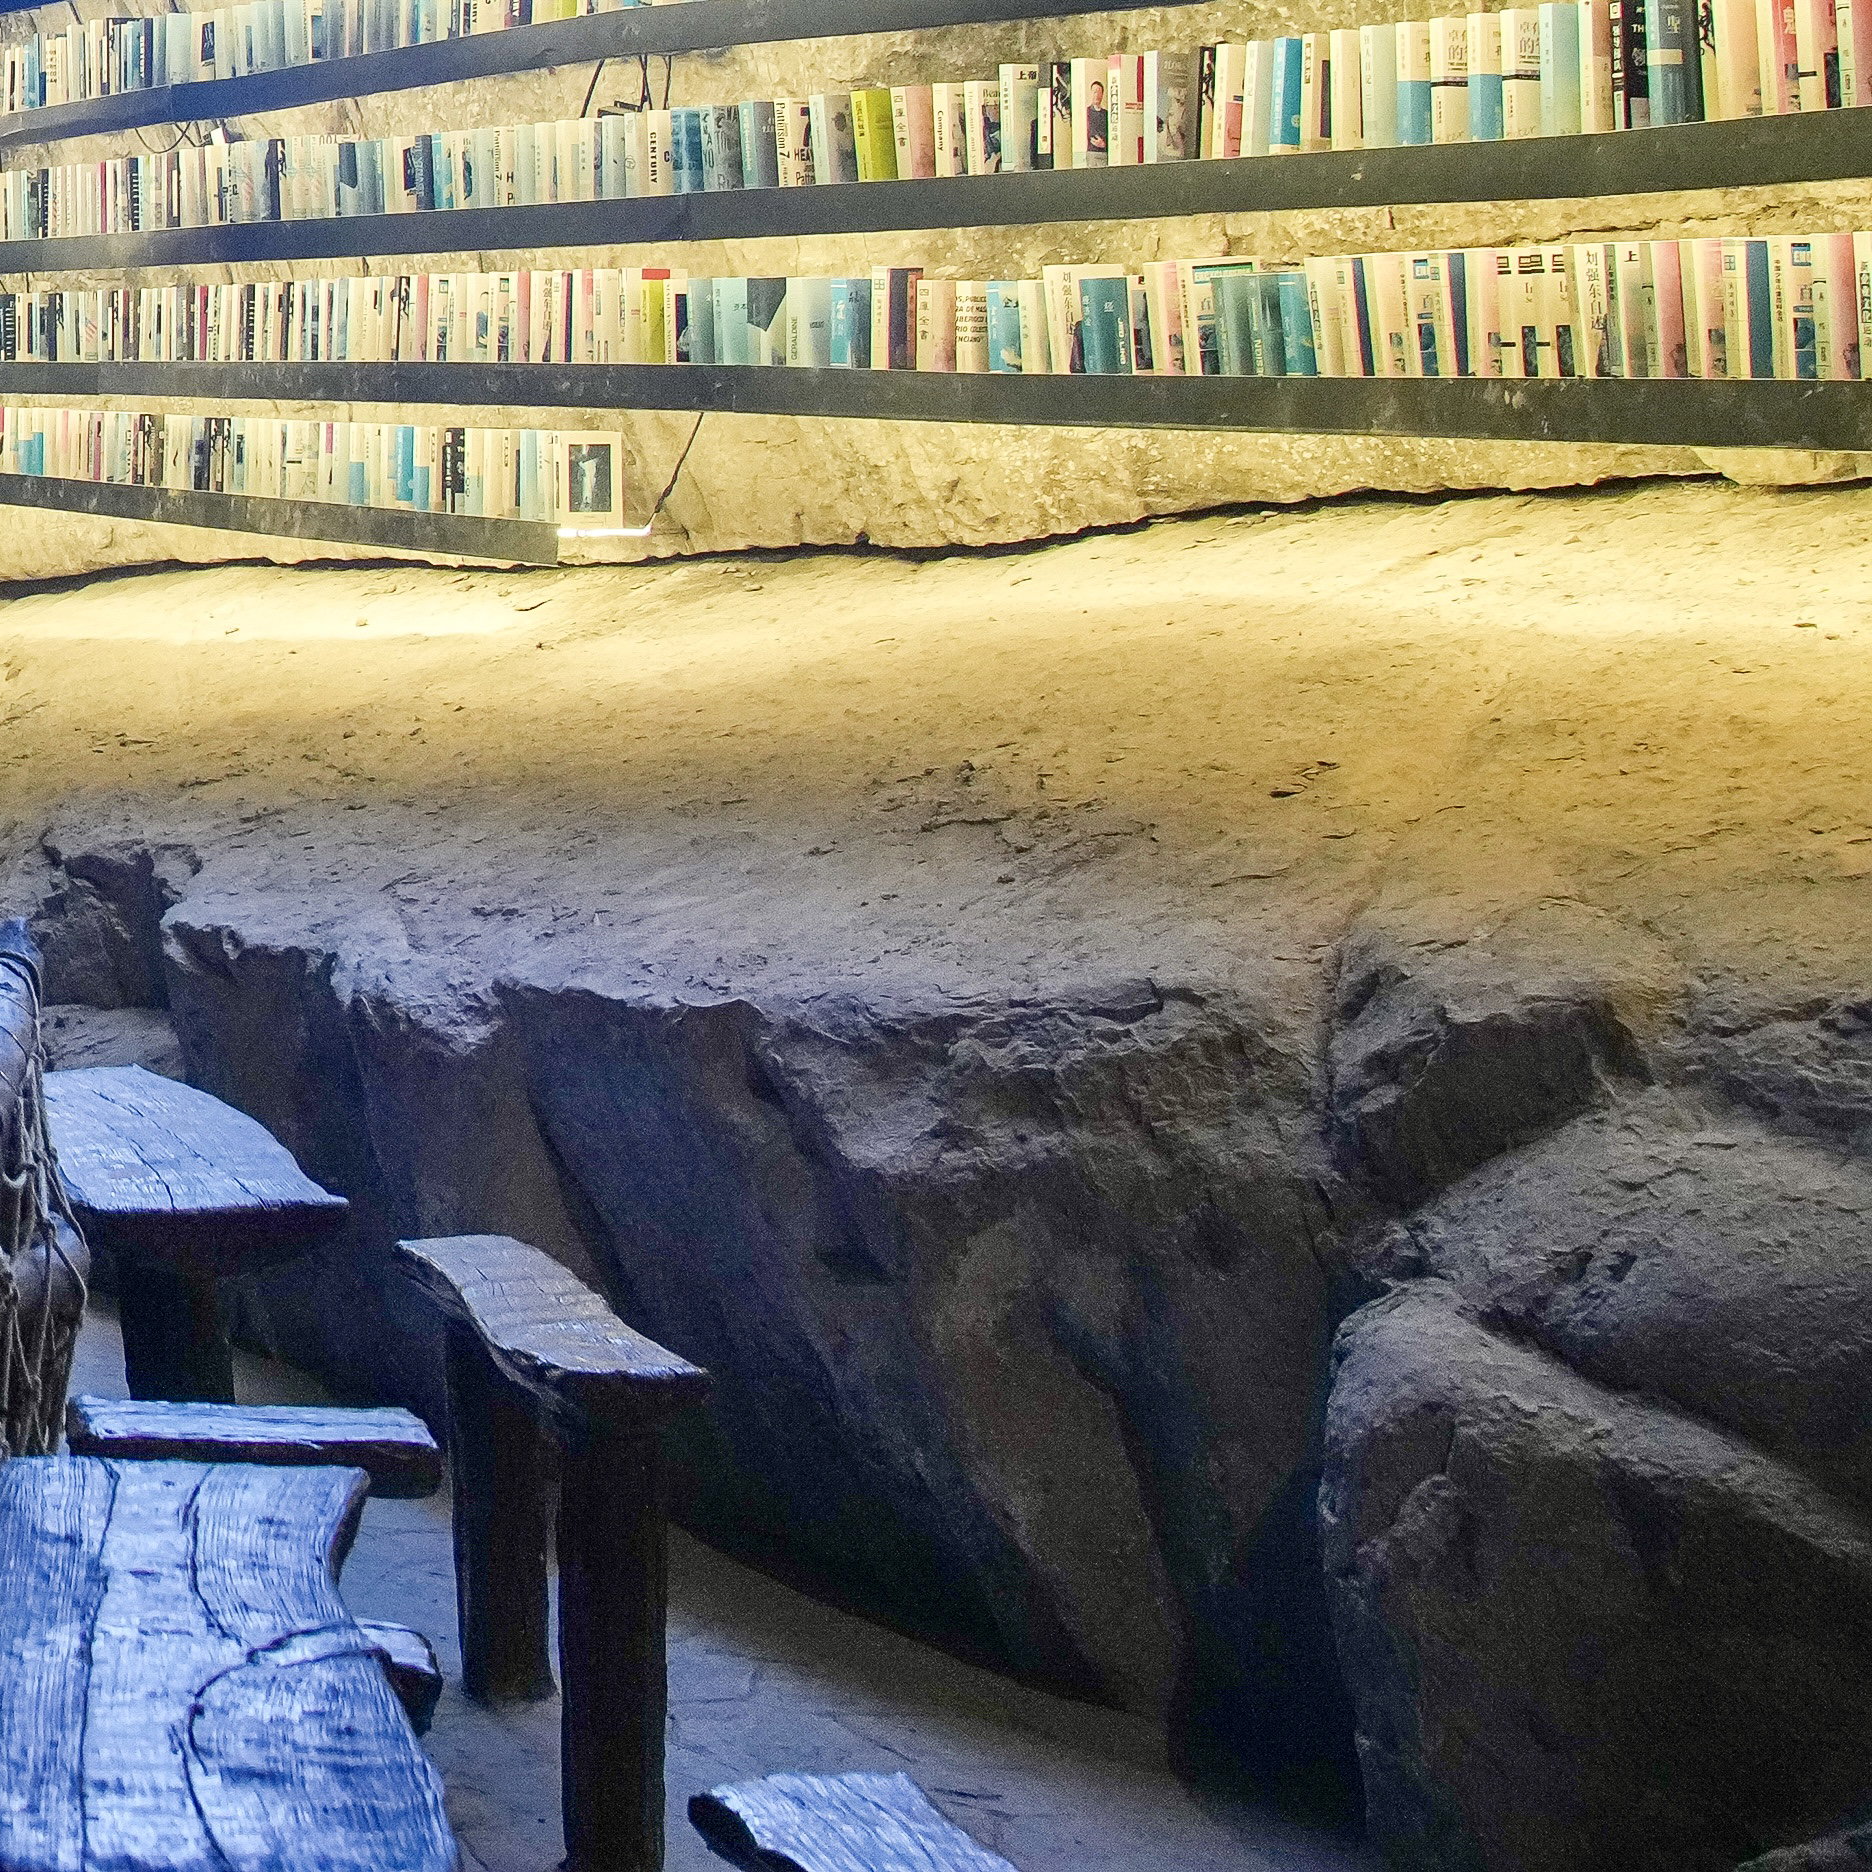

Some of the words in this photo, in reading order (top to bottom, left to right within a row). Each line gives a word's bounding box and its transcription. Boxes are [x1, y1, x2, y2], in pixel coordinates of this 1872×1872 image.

[649, 131, 658, 184] CENTURY
[1586, 249, 1607, 331] 刘强东自述
